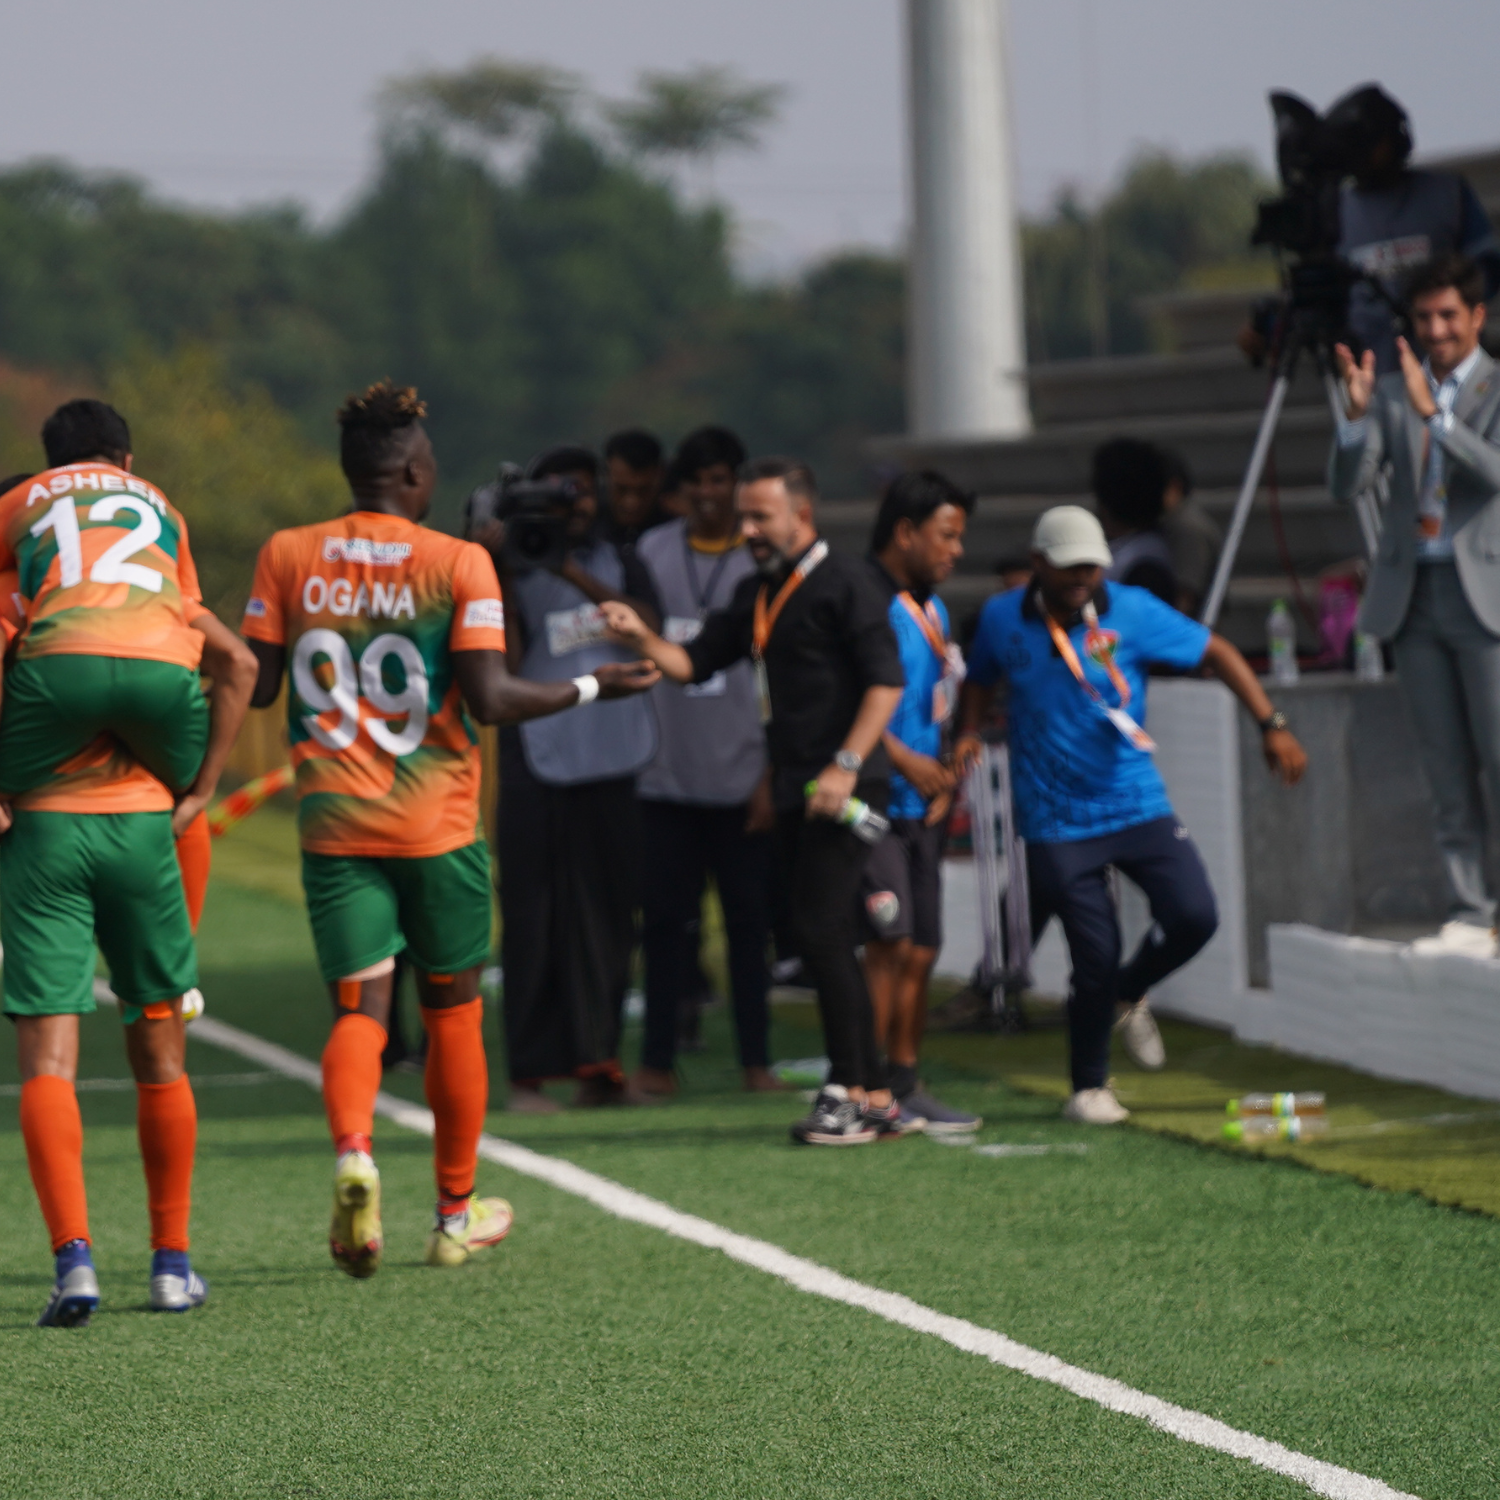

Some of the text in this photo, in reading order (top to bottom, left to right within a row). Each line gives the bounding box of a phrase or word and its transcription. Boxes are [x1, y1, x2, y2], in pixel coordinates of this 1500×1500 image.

[29, 494, 163, 593] 12
[303, 576, 417, 619] OGANA
[292, 628, 429, 756] 99
